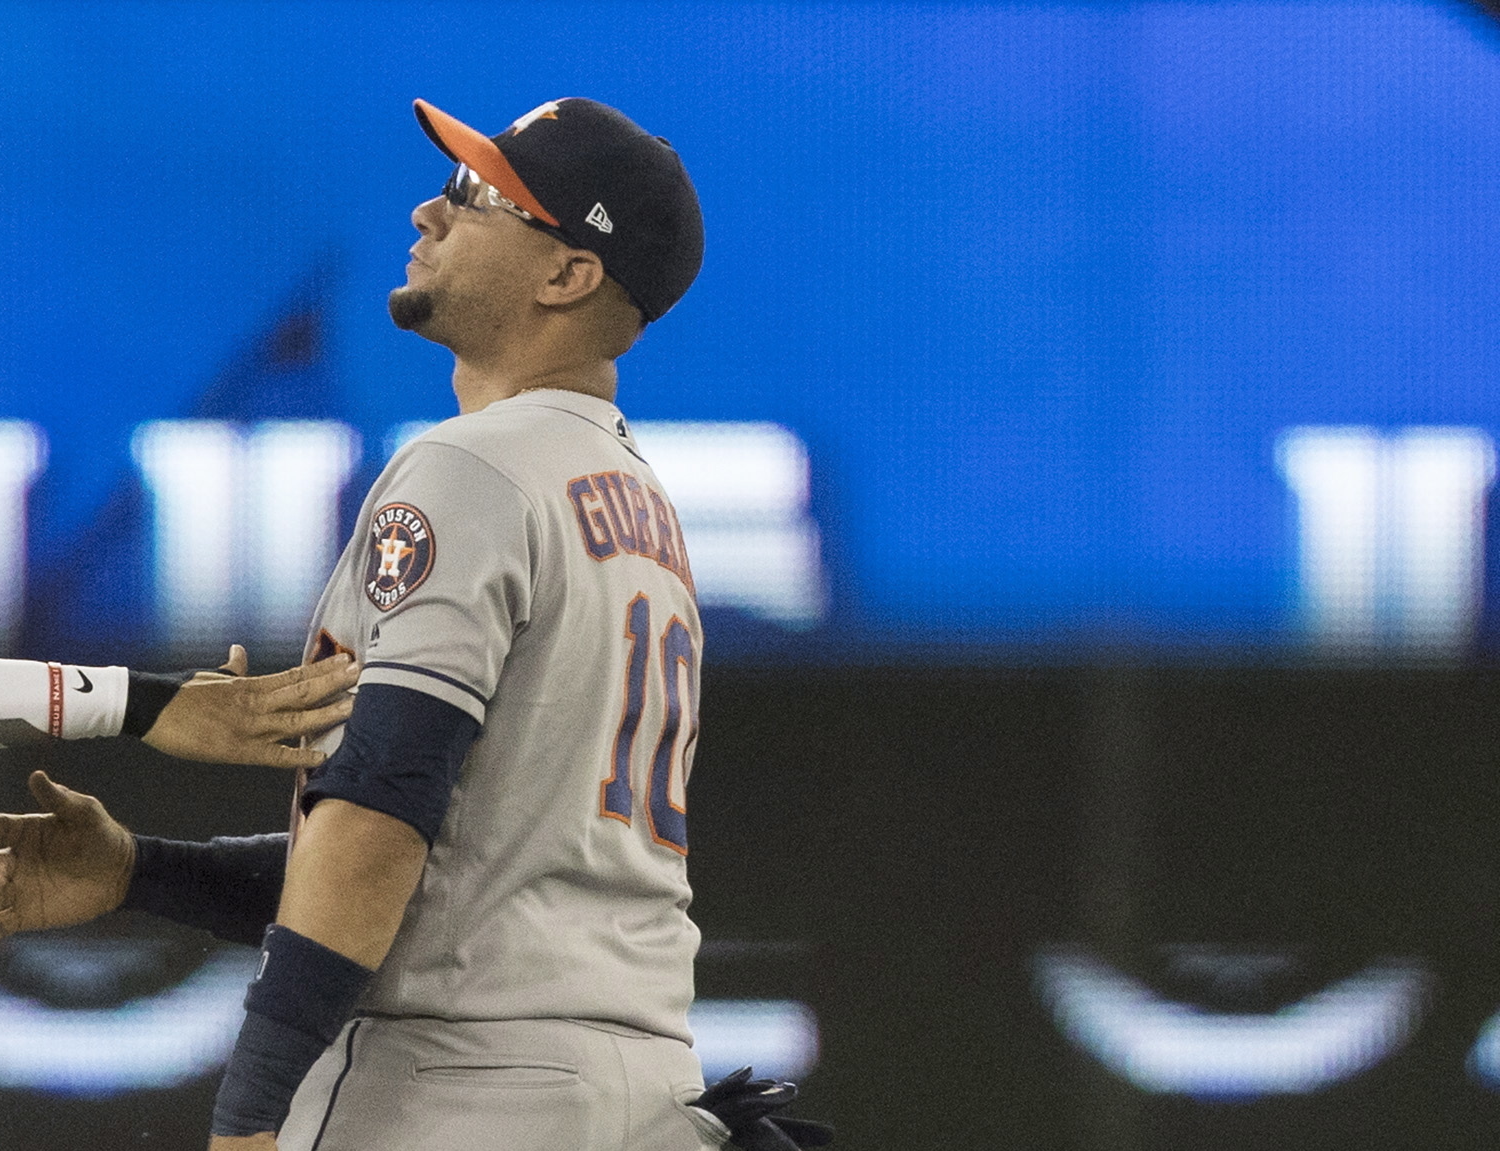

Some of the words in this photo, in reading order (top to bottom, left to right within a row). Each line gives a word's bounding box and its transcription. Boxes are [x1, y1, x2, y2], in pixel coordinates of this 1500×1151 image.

[373, 509, 427, 542] HOUSTON
[378, 538, 406, 577] H
[368, 581, 407, 605] ASTROS
[599, 590, 700, 857] 10
